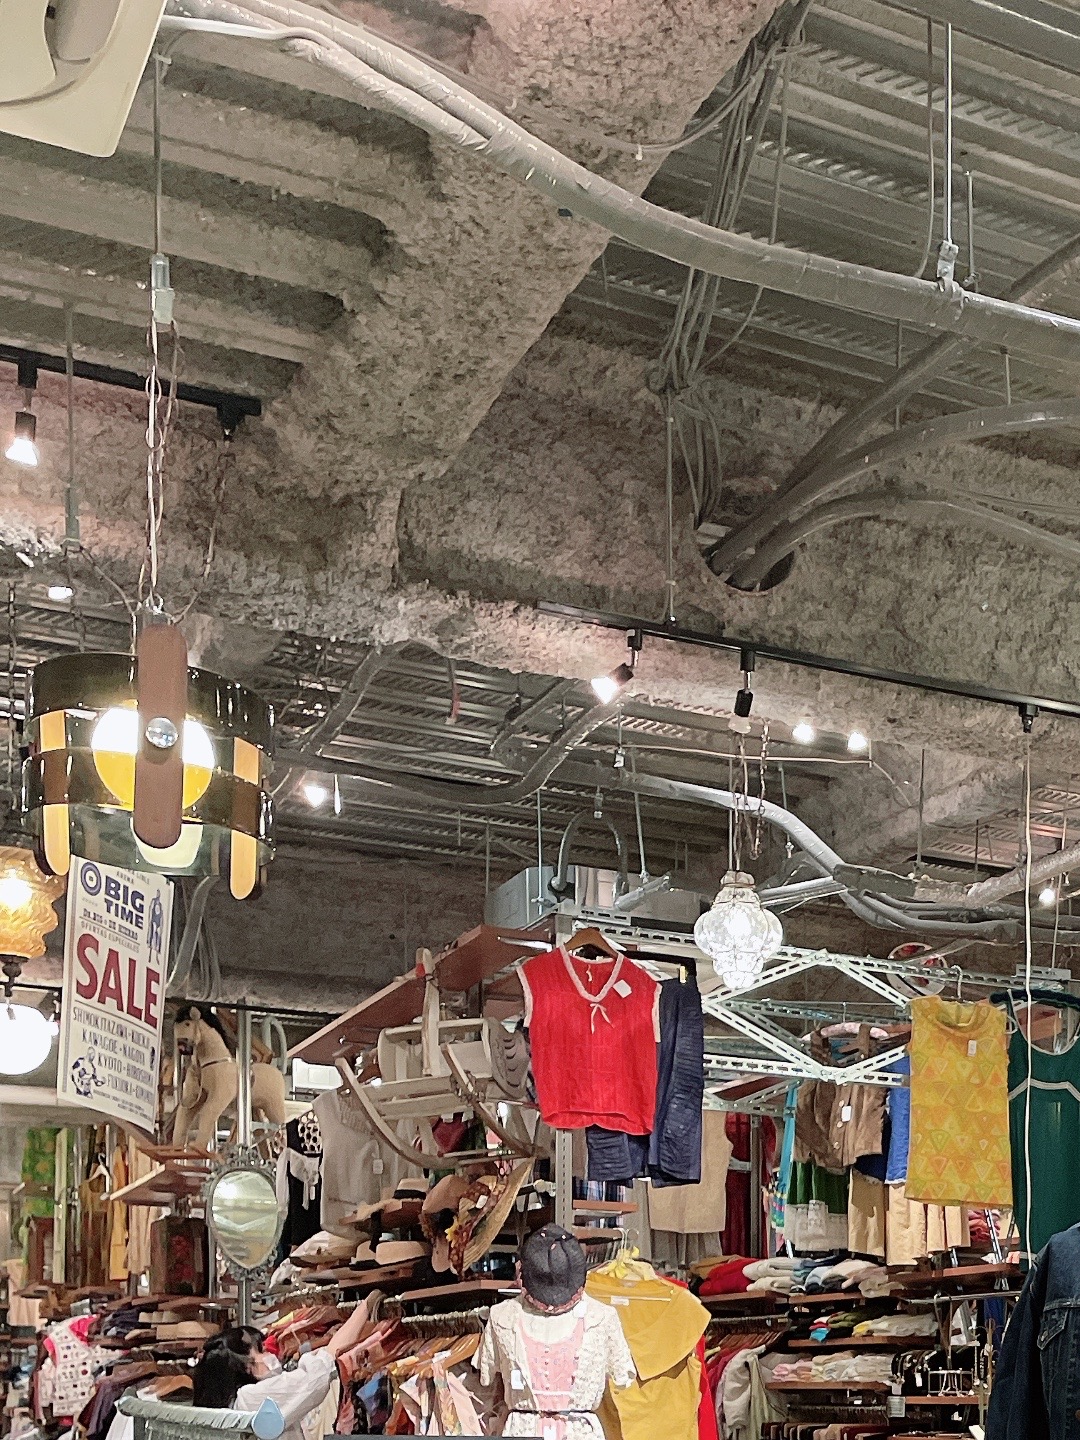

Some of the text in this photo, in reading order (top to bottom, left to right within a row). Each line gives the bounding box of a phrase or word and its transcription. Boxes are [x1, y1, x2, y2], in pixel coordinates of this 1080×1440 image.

[105, 875, 145, 914] BIG
[104, 898, 144, 930] TIME
[75, 933, 160, 1029] SALE
[97, 1052, 123, 1074] KYOTO
